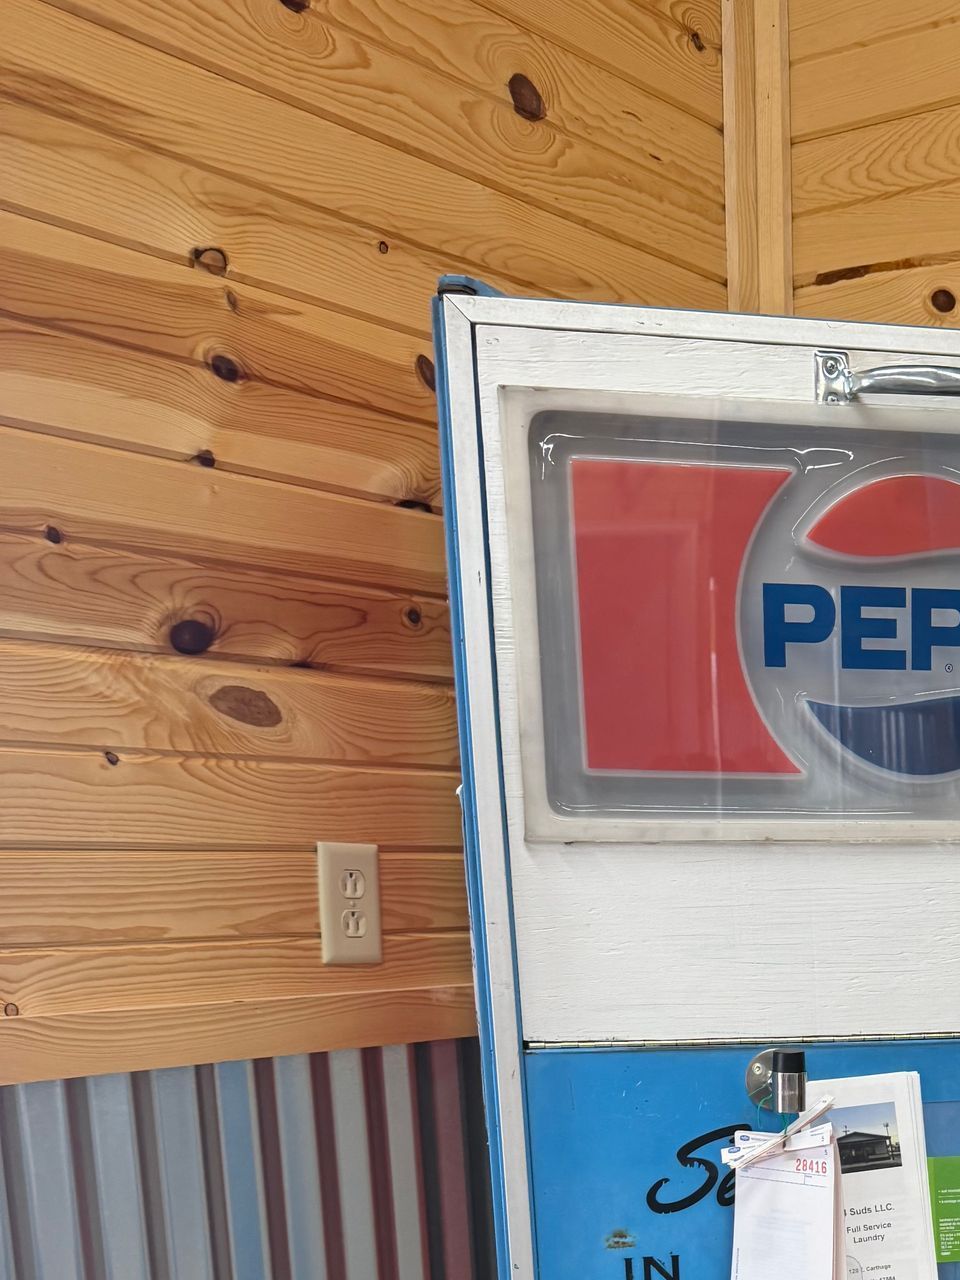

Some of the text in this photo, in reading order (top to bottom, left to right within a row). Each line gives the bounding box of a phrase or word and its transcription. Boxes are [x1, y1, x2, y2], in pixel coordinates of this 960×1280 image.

[795, 1158, 827, 1174] 28416
[849, 1206, 872, 1216] Suds
[846, 1222, 892, 1234] Full Service
[853, 1233, 885, 1244] Laundry
